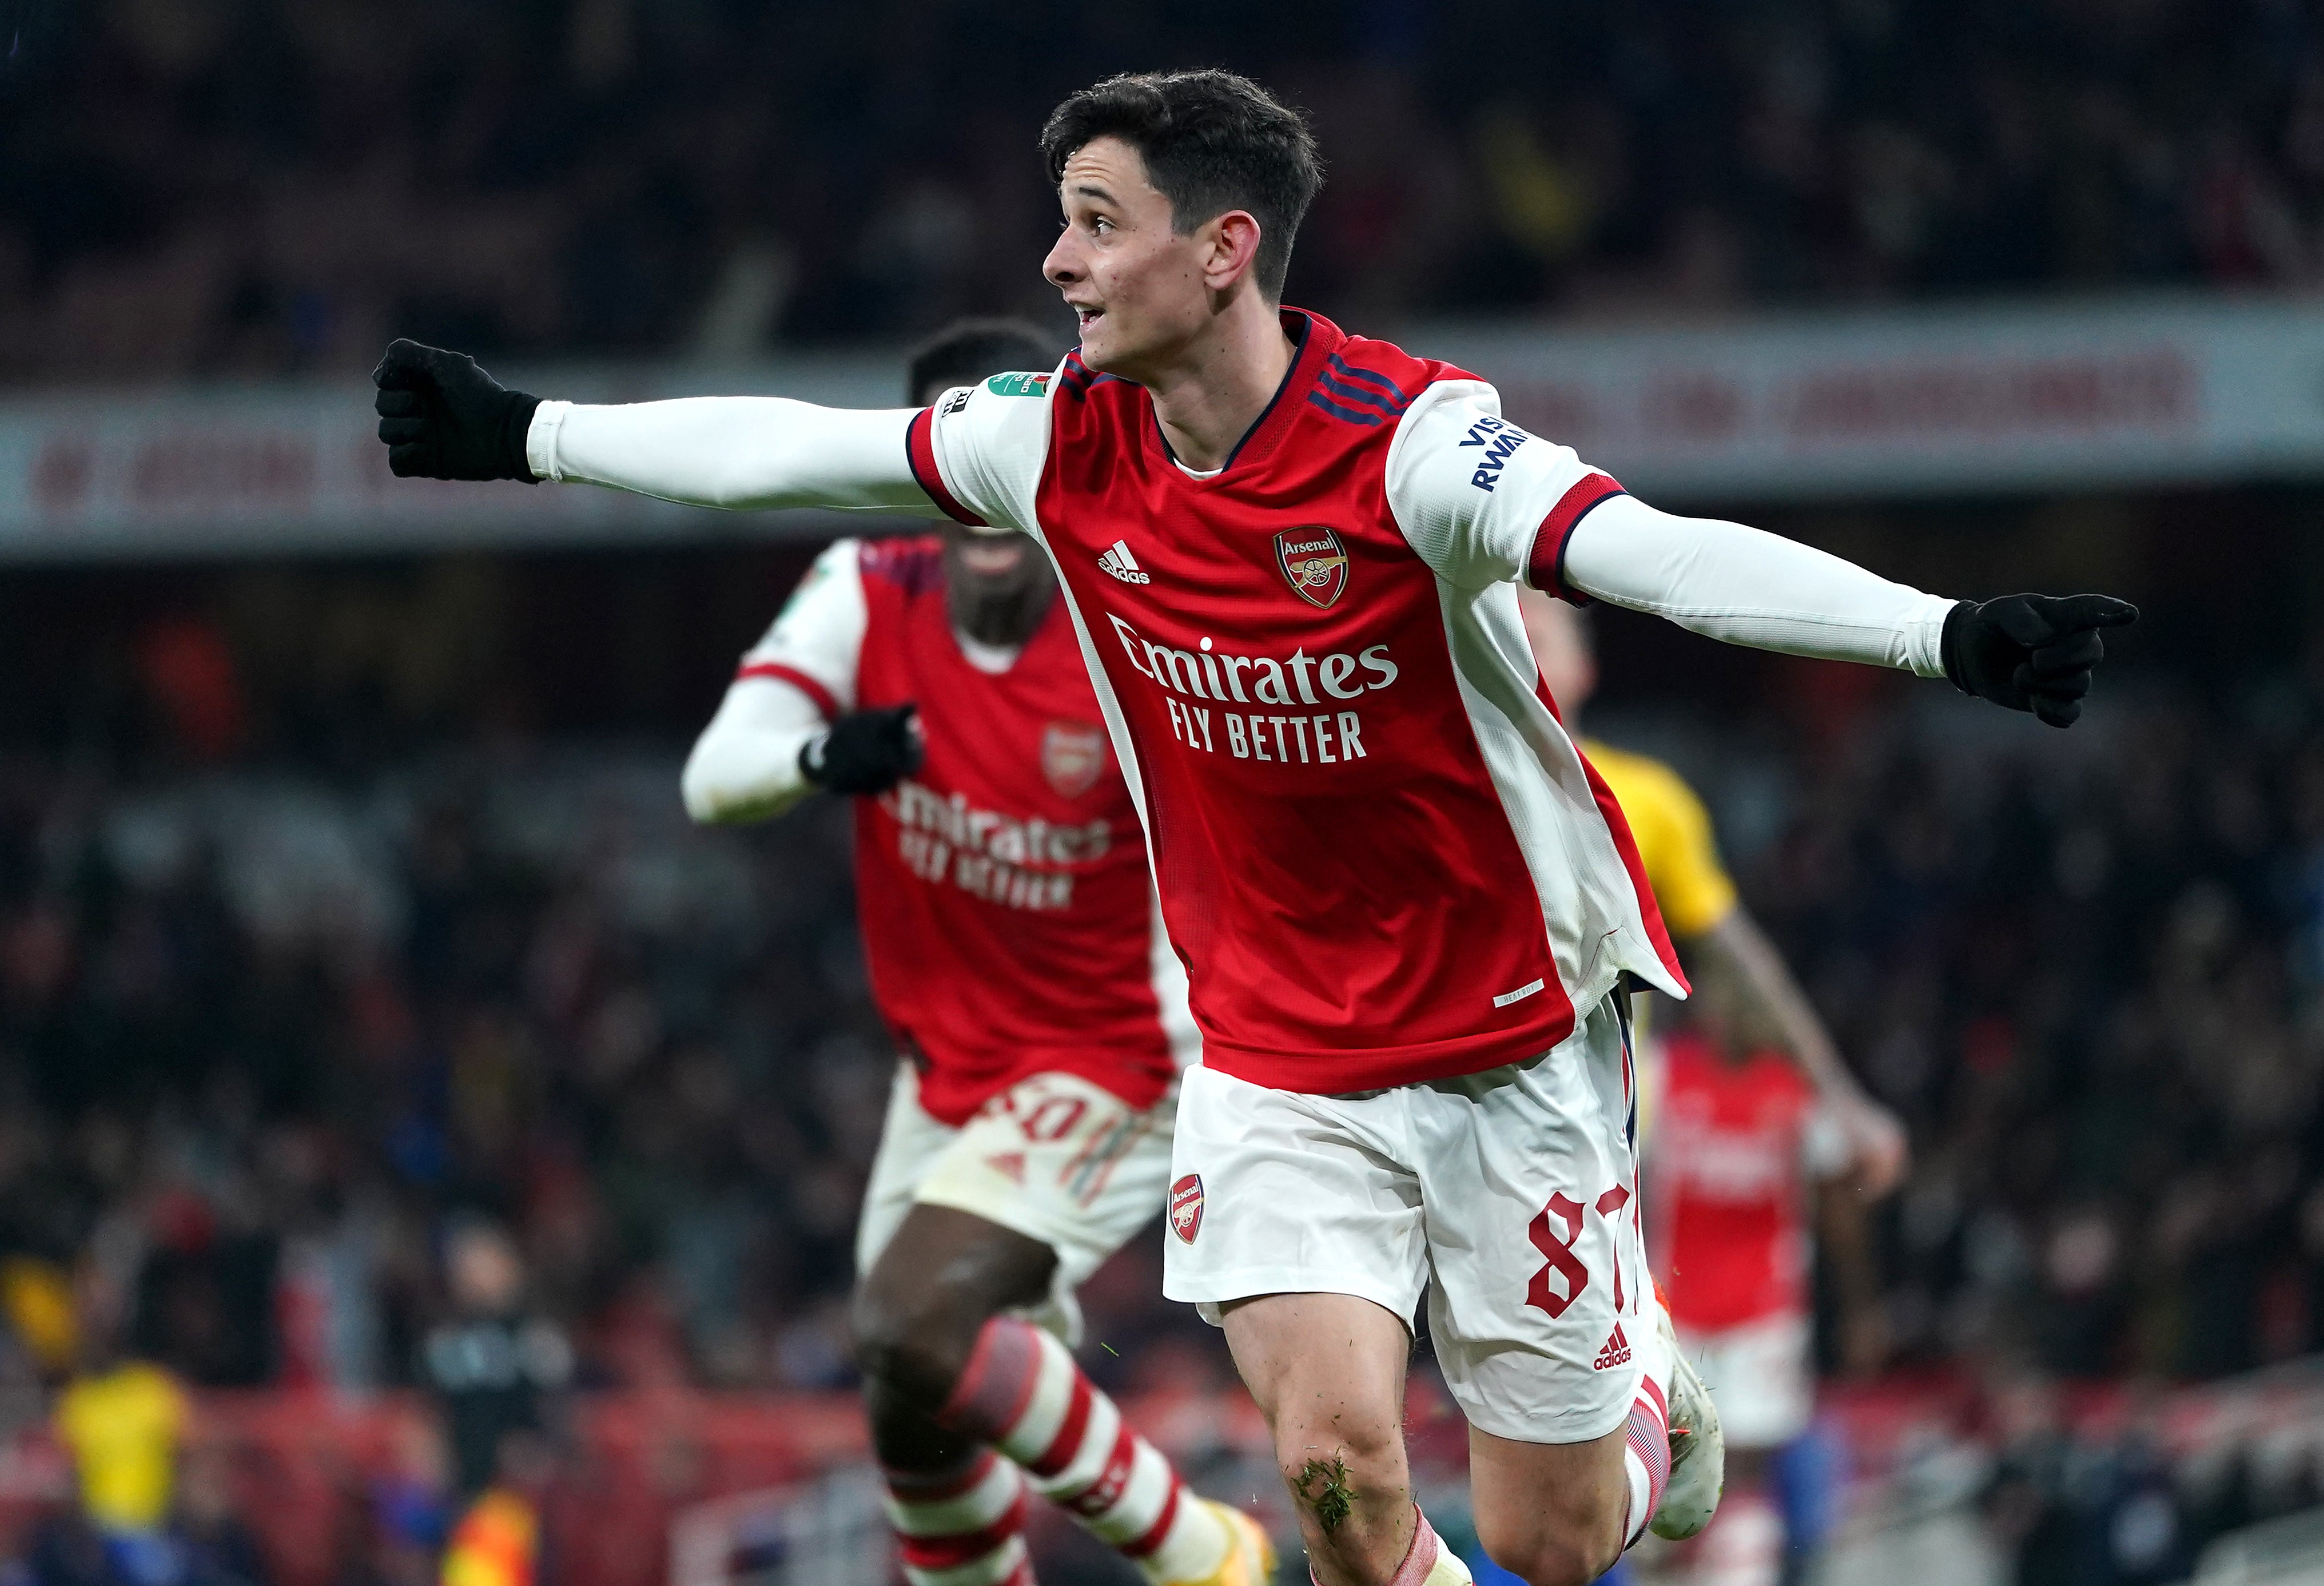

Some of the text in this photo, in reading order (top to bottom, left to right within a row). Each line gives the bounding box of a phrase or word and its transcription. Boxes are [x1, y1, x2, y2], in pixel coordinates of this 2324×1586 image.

[1285, 537, 1335, 555] Arsenal
[1098, 561, 1151, 585] adidas
[1105, 611, 1398, 705] Emirates
[1165, 696, 1367, 764] FLY BETTER
[879, 780, 1113, 864] mirates
[1173, 1182, 1199, 1204] Arsenal
[1593, 1348, 1631, 1371] adidas
